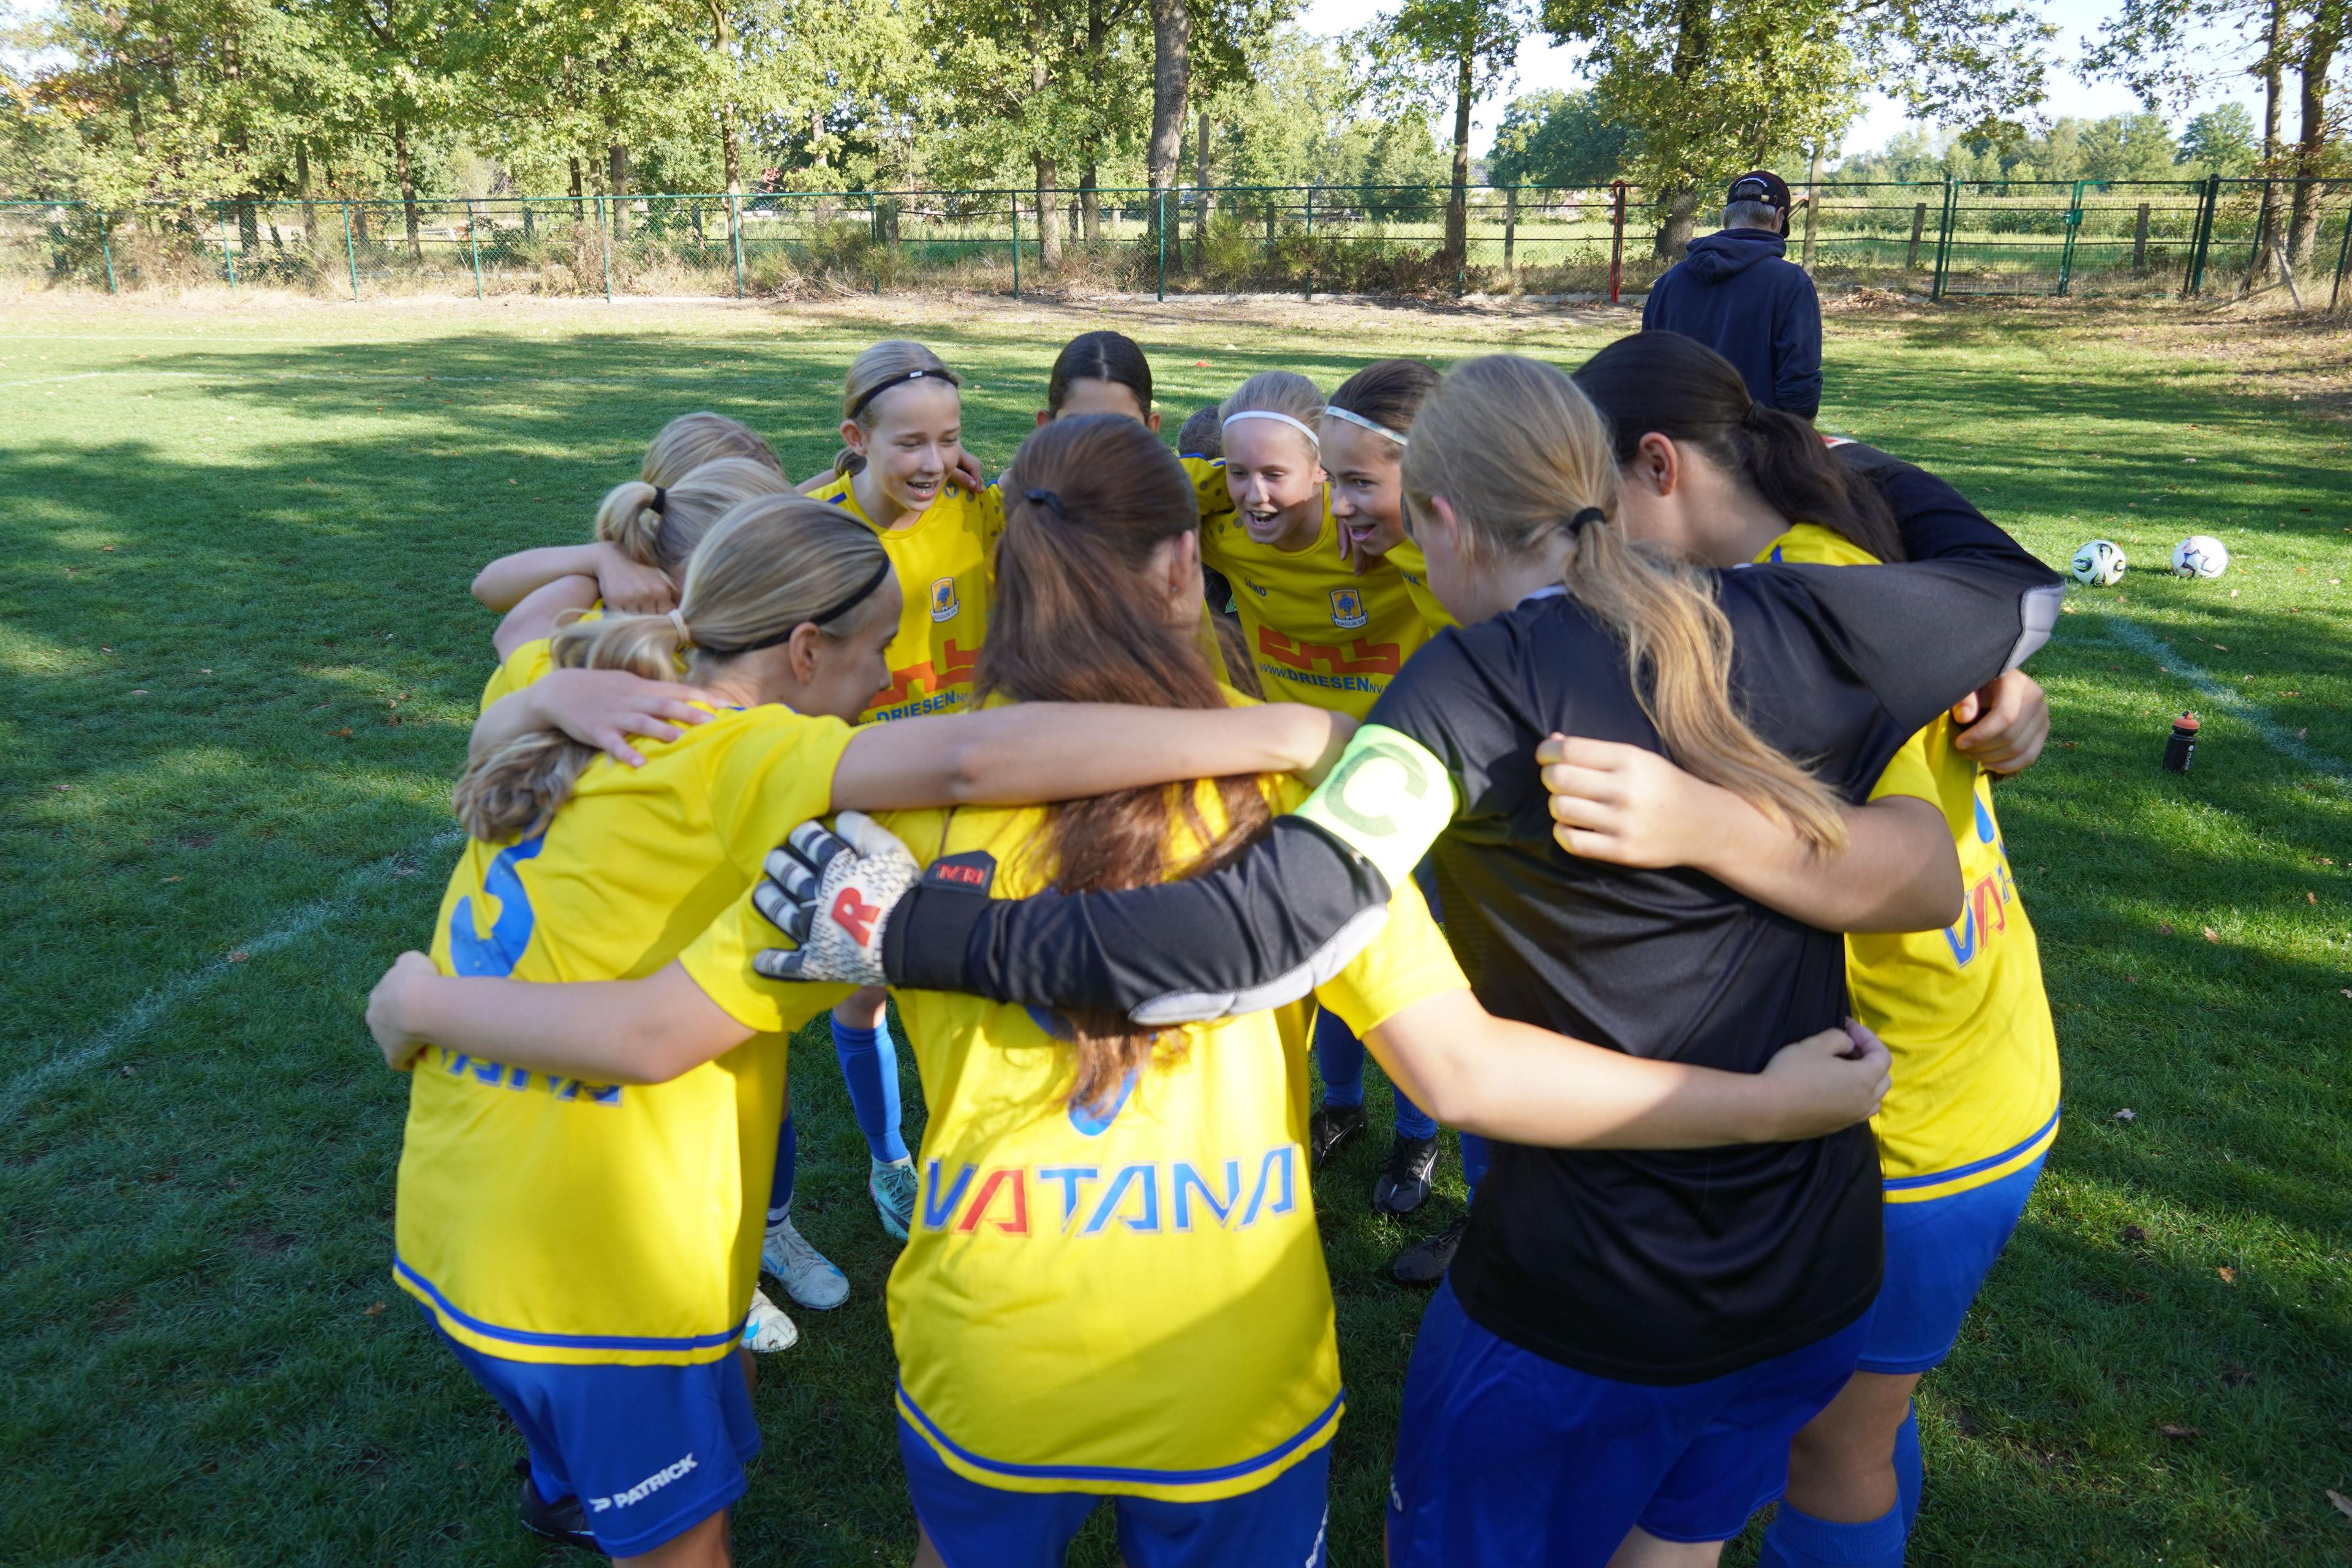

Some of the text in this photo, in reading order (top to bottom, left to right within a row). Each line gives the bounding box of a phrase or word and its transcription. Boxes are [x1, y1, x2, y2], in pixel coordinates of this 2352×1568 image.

[1245, 578, 1267, 597] JAKO
[1324, 742, 1428, 837] C
[831, 887, 880, 948] R
[924, 1142, 1297, 1238] VATANA
[613, 1452, 699, 1509] PATRICK
